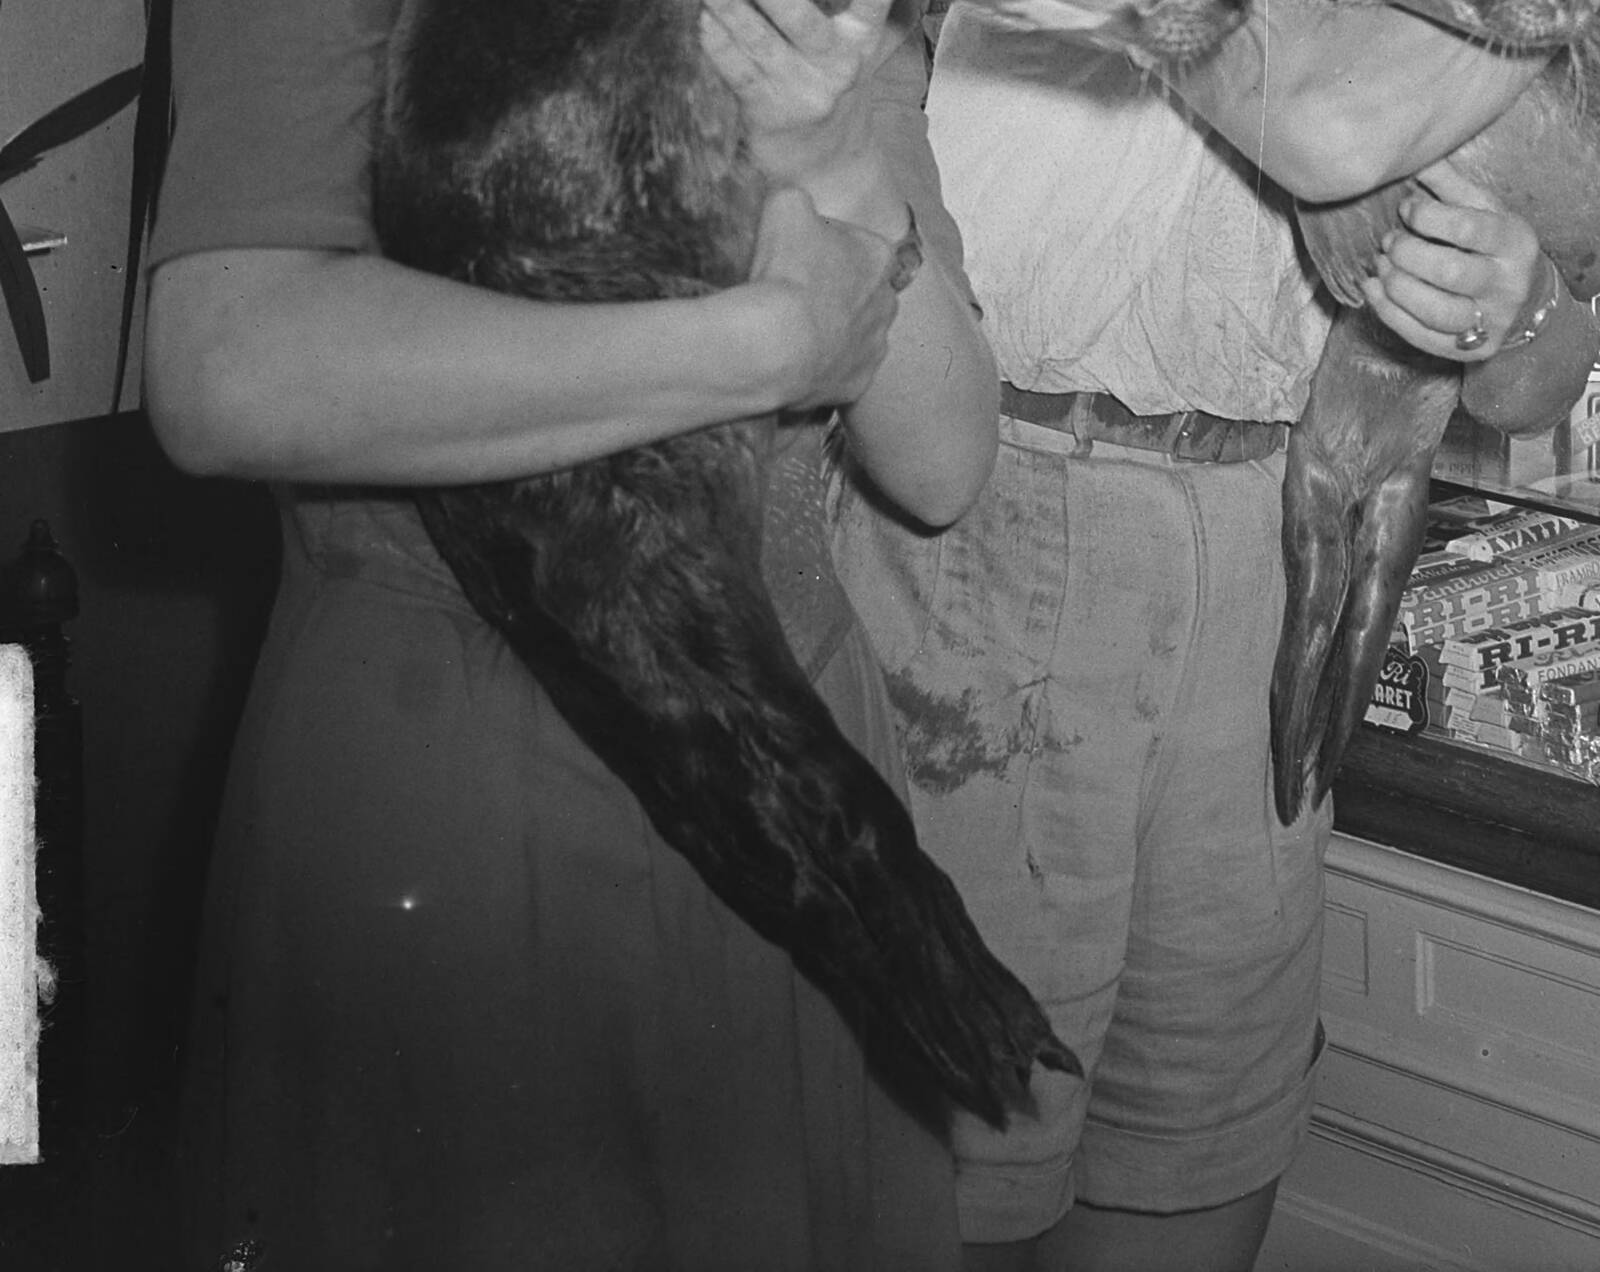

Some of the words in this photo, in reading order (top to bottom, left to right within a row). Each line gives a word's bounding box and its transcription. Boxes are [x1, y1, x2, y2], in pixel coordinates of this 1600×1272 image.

[1401, 564, 1524, 608] Sandwich
[1412, 573, 1541, 631] RI-RI
[1371, 683, 1413, 709] ARET
